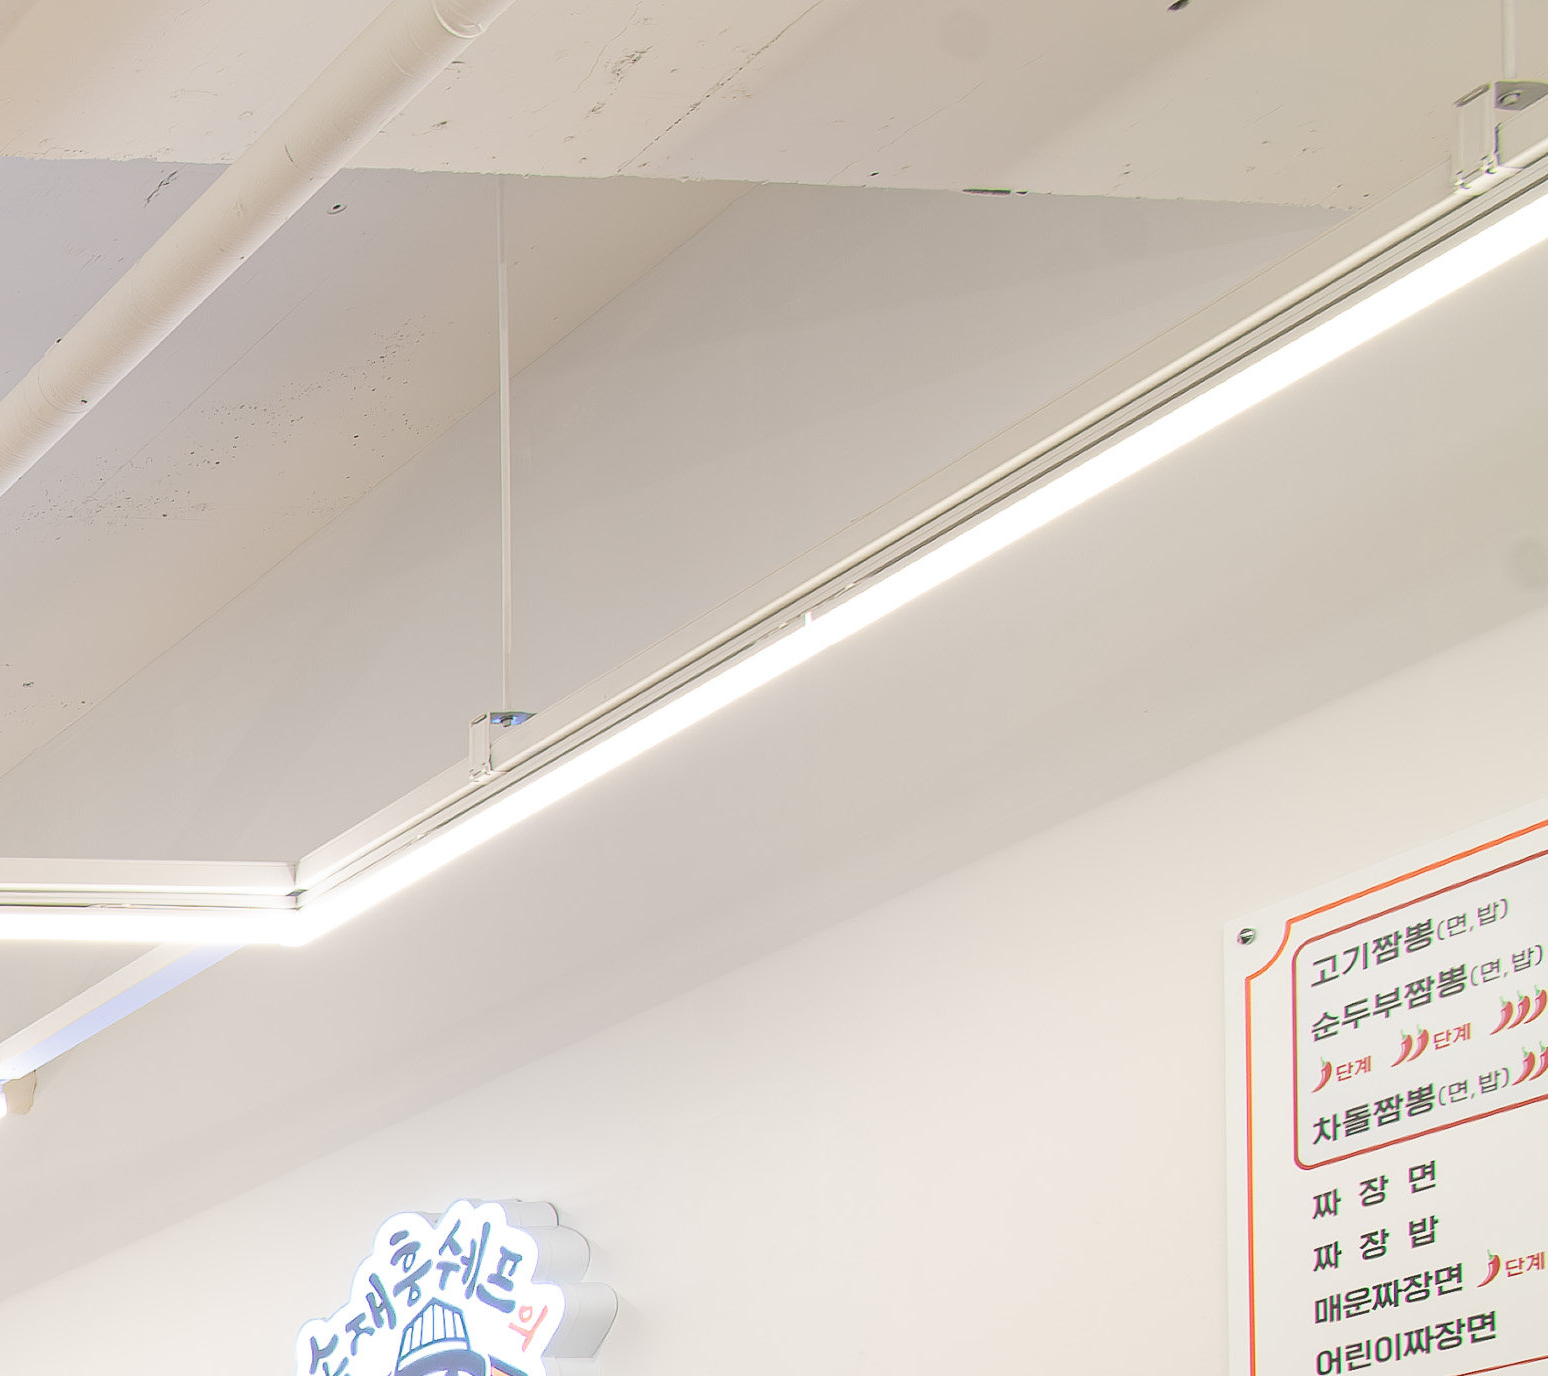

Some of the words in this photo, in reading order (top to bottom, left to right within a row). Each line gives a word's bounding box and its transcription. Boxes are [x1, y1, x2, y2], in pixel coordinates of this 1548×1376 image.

[1433, 1022, 1472, 1050] 단계
[1336, 1055, 1372, 1082] 단계
[1314, 1262, 1464, 1325] 매운짜장면
[1505, 1251, 1546, 1278] 단계
[1316, 1310, 1498, 1376] 어린이짜장면
